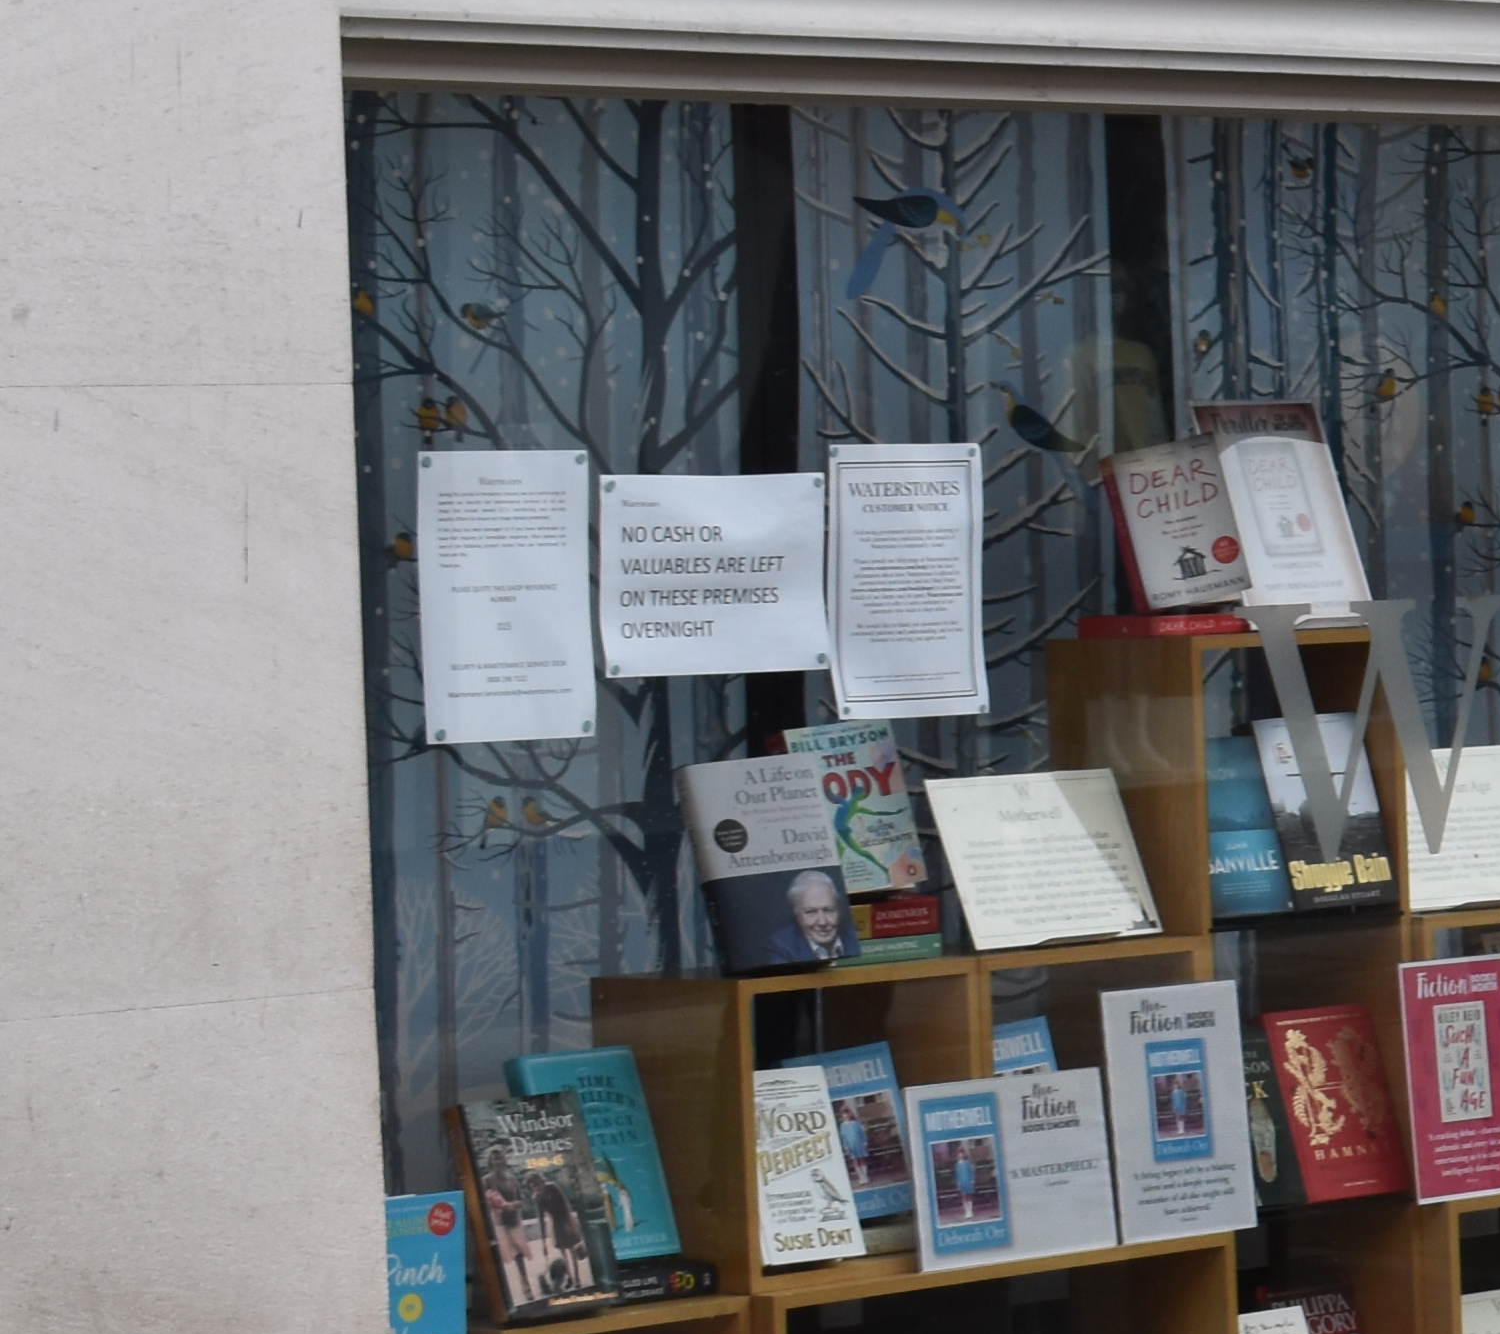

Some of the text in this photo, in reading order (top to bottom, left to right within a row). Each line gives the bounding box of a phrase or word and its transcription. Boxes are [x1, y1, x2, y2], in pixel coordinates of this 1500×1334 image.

[1129, 458, 1217, 495] DEAR
[848, 480, 961, 498] WATERSTONES
[1136, 482, 1219, 519] CHILD
[621, 525, 723, 543] NO CASH OR
[620, 555, 785, 575] VALUABLES ARE LEFT
[620, 586, 779, 607] ON THESE PREMISES
[1152, 576, 1246, 603] ROMY HAUSMANN
[621, 620, 715, 639] OVERNIGHT
[1159, 618, 1217, 633] DEAR CHILD
[790, 727, 889, 753] BILL BRYSON
[821, 751, 857, 768] THE
[744, 767, 814, 786] A Life on
[734, 784, 819, 806] Our Planet
[783, 825, 829, 845] David
[727, 846, 833, 869] Attenborough
[1352, 851, 1392, 884] Bain
[1416, 971, 1468, 999] Fiction
[1129, 1010, 1183, 1036] Fiction
[519, 1101, 536, 1113] The
[1021, 1095, 1077, 1121] Fiction
[497, 1110, 574, 1135] Windsor
[510, 1135, 574, 1157] Diaries
[757, 1132, 834, 1187] PERFECT
[774, 1226, 854, 1253] SUSIE DENT
[937, 1227, 983, 1247] Deborah
